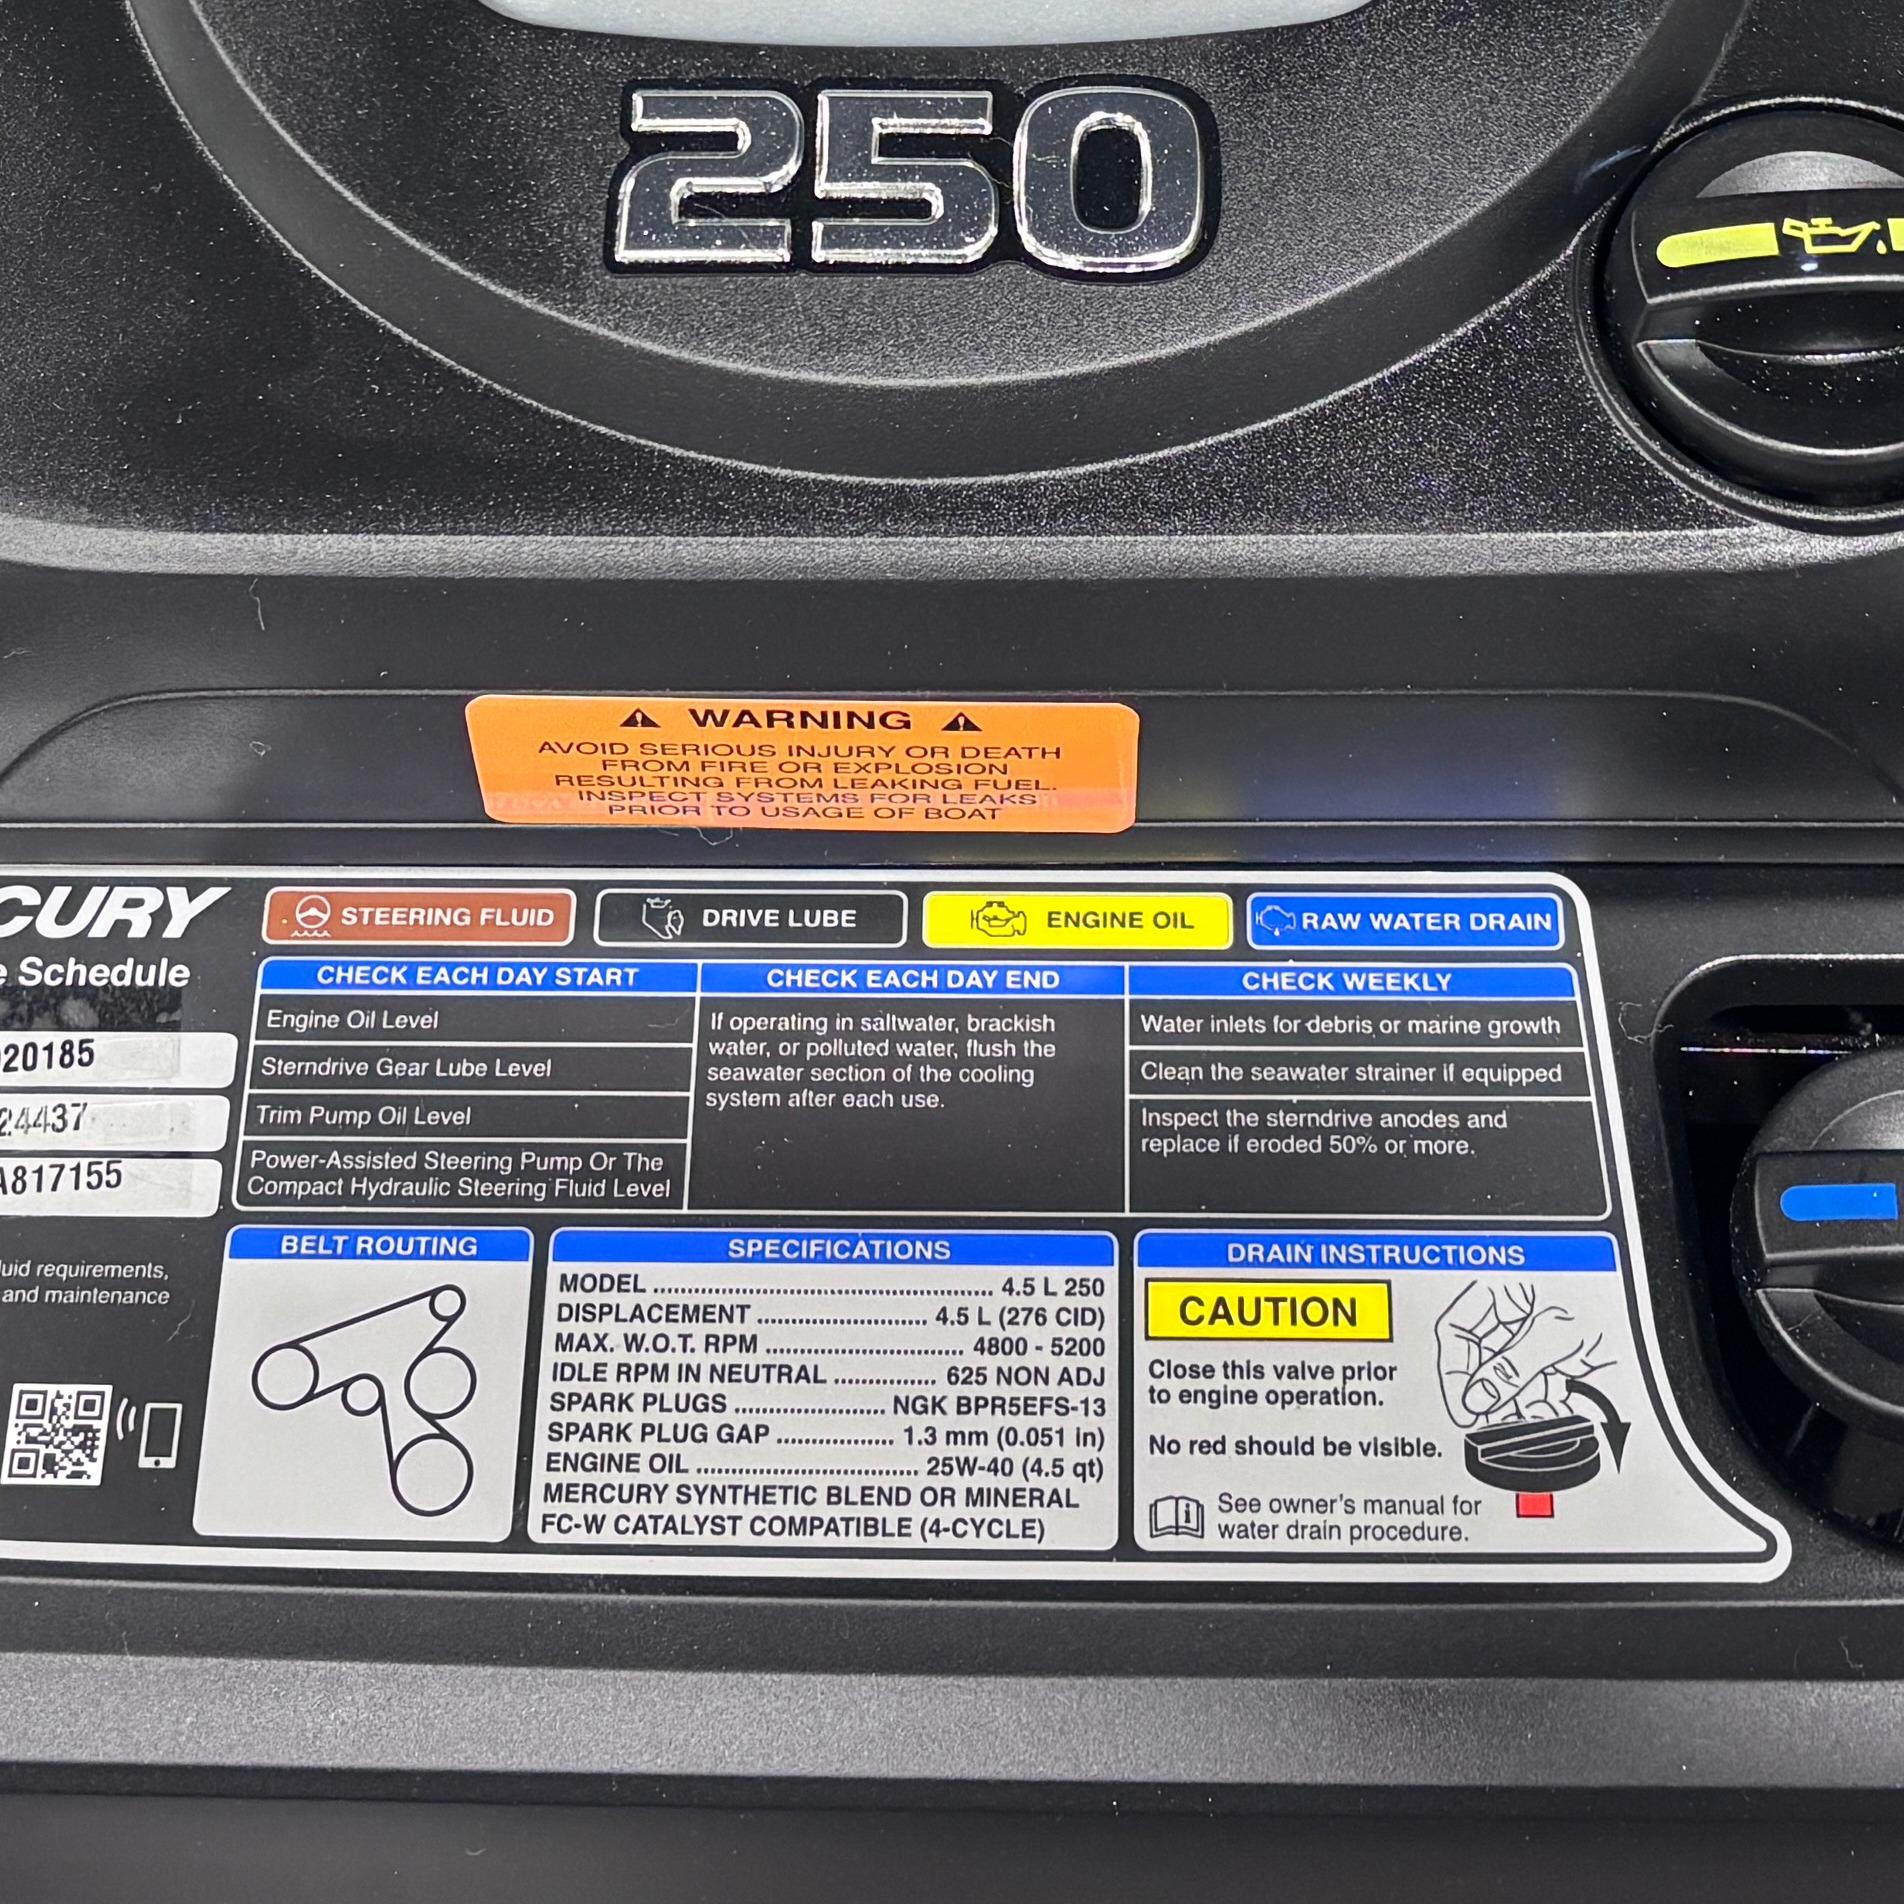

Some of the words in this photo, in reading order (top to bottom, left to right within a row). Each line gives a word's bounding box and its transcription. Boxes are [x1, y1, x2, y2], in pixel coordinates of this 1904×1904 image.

[613, 86, 1206, 273] 250
[688, 708, 911, 730] WARNING
[537, 740, 629, 755] AVOID
[639, 742, 776, 757] SERIOUS
[787, 744, 896, 758] INJURY
[904, 745, 949, 759] OR
[960, 746, 1061, 760] DEATH
[601, 758, 690, 772] FROM
[700, 760, 768, 774] FIRE
[777, 760, 822, 774] OR
[832, 761, 1008, 776] EXPLOSION
[554, 774, 724, 788] RESULTING
[735, 776, 823, 789] FROM
[832, 777, 963, 790] LEAKING
[973, 778, 1056, 791] FUEL.
[577, 789, 707, 802] INSPECT
[716, 791, 859, 804] SYSTEMS
[869, 792, 931, 804] FOR
[942, 793, 1037, 805] LEAKS
[608, 804, 701, 816] PRIOR
[710, 804, 751, 817] TO
[760, 805, 865, 819] USAGE
[873, 806, 915, 819] OF
[924, 806, 1001, 820] BOAT
[340, 906, 471, 926] STEERING
[479, 907, 554, 926] FLUID
[702, 908, 779, 927] DRIVE
[787, 908, 857, 928] LUBE
[1047, 910, 1144, 929] ENGINE
[1152, 910, 1195, 929] OIL
[1302, 912, 1361, 930] RAW
[1368, 912, 1460, 931] WATER
[1469, 912, 1552, 931] DRAIN
[17, 955, 191, 987] Schedule
[316, 965, 408, 985] CHECK
[416, 965, 488, 985] EACH
[496, 966, 548, 986] DAY
[554, 966, 639, 986] START
[766, 968, 858, 988] CHECK
[866, 969, 938, 988] EACH
[946, 969, 998, 989] DAY
[1005, 969, 1060, 989] END
[1242, 971, 1334, 991] CHECK
[1342, 972, 1452, 991] WEEKLY
[266, 1008, 340, 1033] Engine
[346, 1009, 376, 1029] Oil
[382, 1009, 438, 1029] Level
[1140, 1013, 1204, 1033] Water
[1210, 1014, 1266, 1034] inlets
[1272, 1014, 1301, 1033] for
[1309, 1016, 1372, 1035] debris
[1378, 1018, 1401, 1034] or
[1407, 1014, 1481, 1034] marine
[1487, 1015, 1561, 1039] growth
[280, 1234, 349, 1255] BELT
[356, 1235, 477, 1256] ROUTING
[728, 1238, 950, 1260] SPECIFICATIONS
[1227, 1242, 1314, 1263] DRAIN
[1320, 1243, 1525, 1265] INSTRUCTIONS
[559, 1272, 647, 1293] MODEL
[1001, 1276, 1036, 1297] 4.5
[1043, 1275, 1058, 1297] L
[1064, 1276, 1105, 1297] 250
[556, 1302, 751, 1324] DISPLACEMENT
[934, 1305, 969, 1326] 4.5
[977, 1305, 992, 1326] L
[998, 1305, 1048, 1331] (276
[1054, 1306, 1105, 1331] CID)
[1178, 1295, 1357, 1327] CAUTION
[554, 1331, 614, 1353] MAX.
[622, 1332, 696, 1354] W.O.T.
[704, 1333, 758, 1354] RPM
[972, 1335, 1028, 1356] 4800
[1050, 1336, 1105, 1357] 5200
[551, 1361, 608, 1382] IDLE
[615, 1362, 669, 1383] RPM
[676, 1362, 701, 1383] IN
[708, 1363, 827, 1384] NEUTRAL
[946, 1365, 988, 1386] 625
[996, 1365, 1050, 1386] NON
[1056, 1366, 1105, 1387] ADJ
[1148, 1358, 1216, 1380] Close
[1221, 1358, 1265, 1380] this
[1272, 1359, 1335, 1381] valve
[1341, 1360, 1397, 1386] prior
[549, 1391, 634, 1413] SPARK
[642, 1392, 727, 1414] PLUGS
[892, 1394, 947, 1416] NGK
[955, 1395, 1106, 1417] BPR5EFS-13
[1147, 1384, 1171, 1404] to
[1177, 1383, 1258, 1410] engine
[1264, 1384, 1384, 1410] operation.
[547, 1420, 633, 1443] SPARK
[640, 1422, 708, 1444] PLUG
[715, 1422, 770, 1444] GAP
[903, 1425, 937, 1446] 1.3
[945, 1429, 988, 1447] mm
[996, 1425, 1064, 1452] (0.051
[1075, 1426, 1105, 1452] in)
[1148, 1433, 1181, 1455] No
[1188, 1434, 1226, 1456] red
[1234, 1434, 1315, 1456] should
[1322, 1435, 1352, 1457] be
[1357, 1436, 1442, 1458] visible.
[545, 1451, 641, 1473] ENGINE
[648, 1452, 689, 1474] OIL
[926, 1455, 1014, 1477] 25W-40
[1021, 1456, 1064, 1482] (4.5
[1072, 1456, 1104, 1484] qt)
[542, 1482, 669, 1504] MERCURY
[675, 1483, 817, 1506] SYNTHETIC
[826, 1484, 911, 1507] BLEND
[919, 1485, 956, 1507] OR
[964, 1486, 1080, 1509] MINERAL
[540, 1512, 607, 1535] FC-W
[613, 1513, 743, 1536] CATALYST
[748, 1514, 912, 1538] COMPATIBLE
[920, 1516, 1045, 1544] (4-CYCLE)
